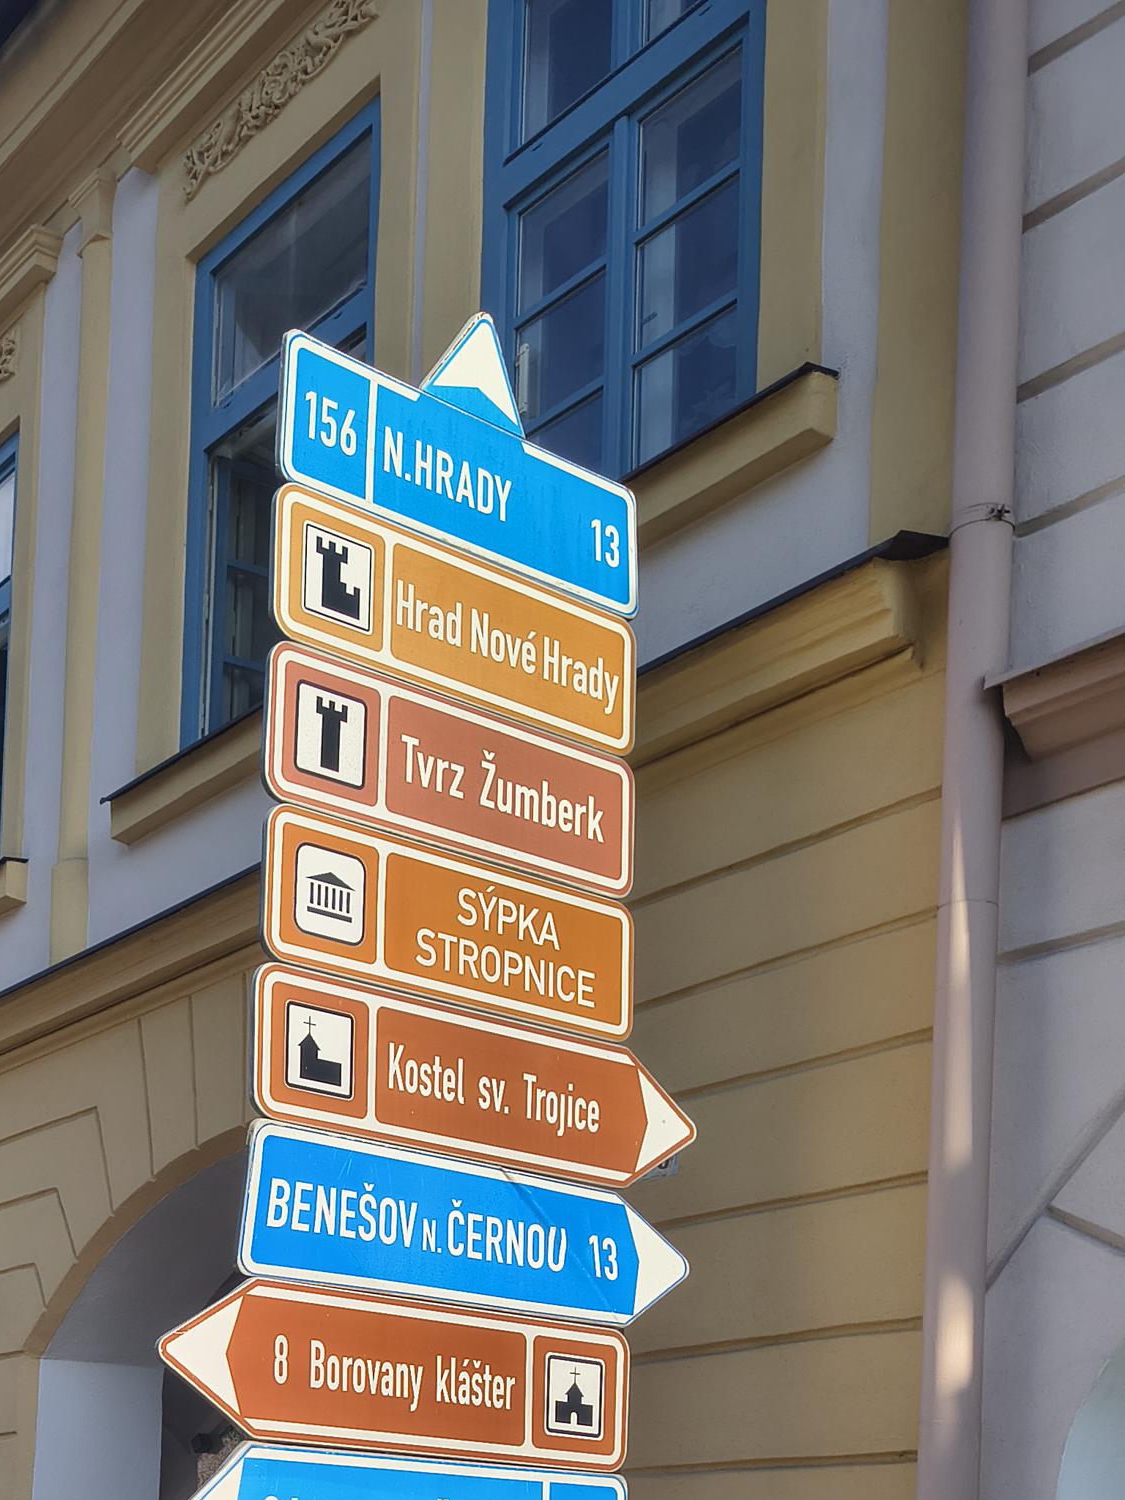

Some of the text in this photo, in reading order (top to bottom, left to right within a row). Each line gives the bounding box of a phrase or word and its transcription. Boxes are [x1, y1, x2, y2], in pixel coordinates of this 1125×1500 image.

[305, 391, 357, 456] 156
[383, 426, 512, 522] N.HRADY
[591, 519, 620, 567] 13
[396, 580, 619, 715] Hrad Nové Hrady
[401, 734, 605, 843] Tvrz Žumberk
[457, 886, 560, 951] SÝPKA
[415, 928, 595, 1008] STROPNICE
[388, 1042, 601, 1137] Kostel sv. Trojice
[266, 1177, 419, 1248] BENEŠOV
[448, 1199, 567, 1272] ČERNOU
[588, 1234, 618, 1281] 13
[273, 1335, 516, 1412] 8 Borovany klášter
